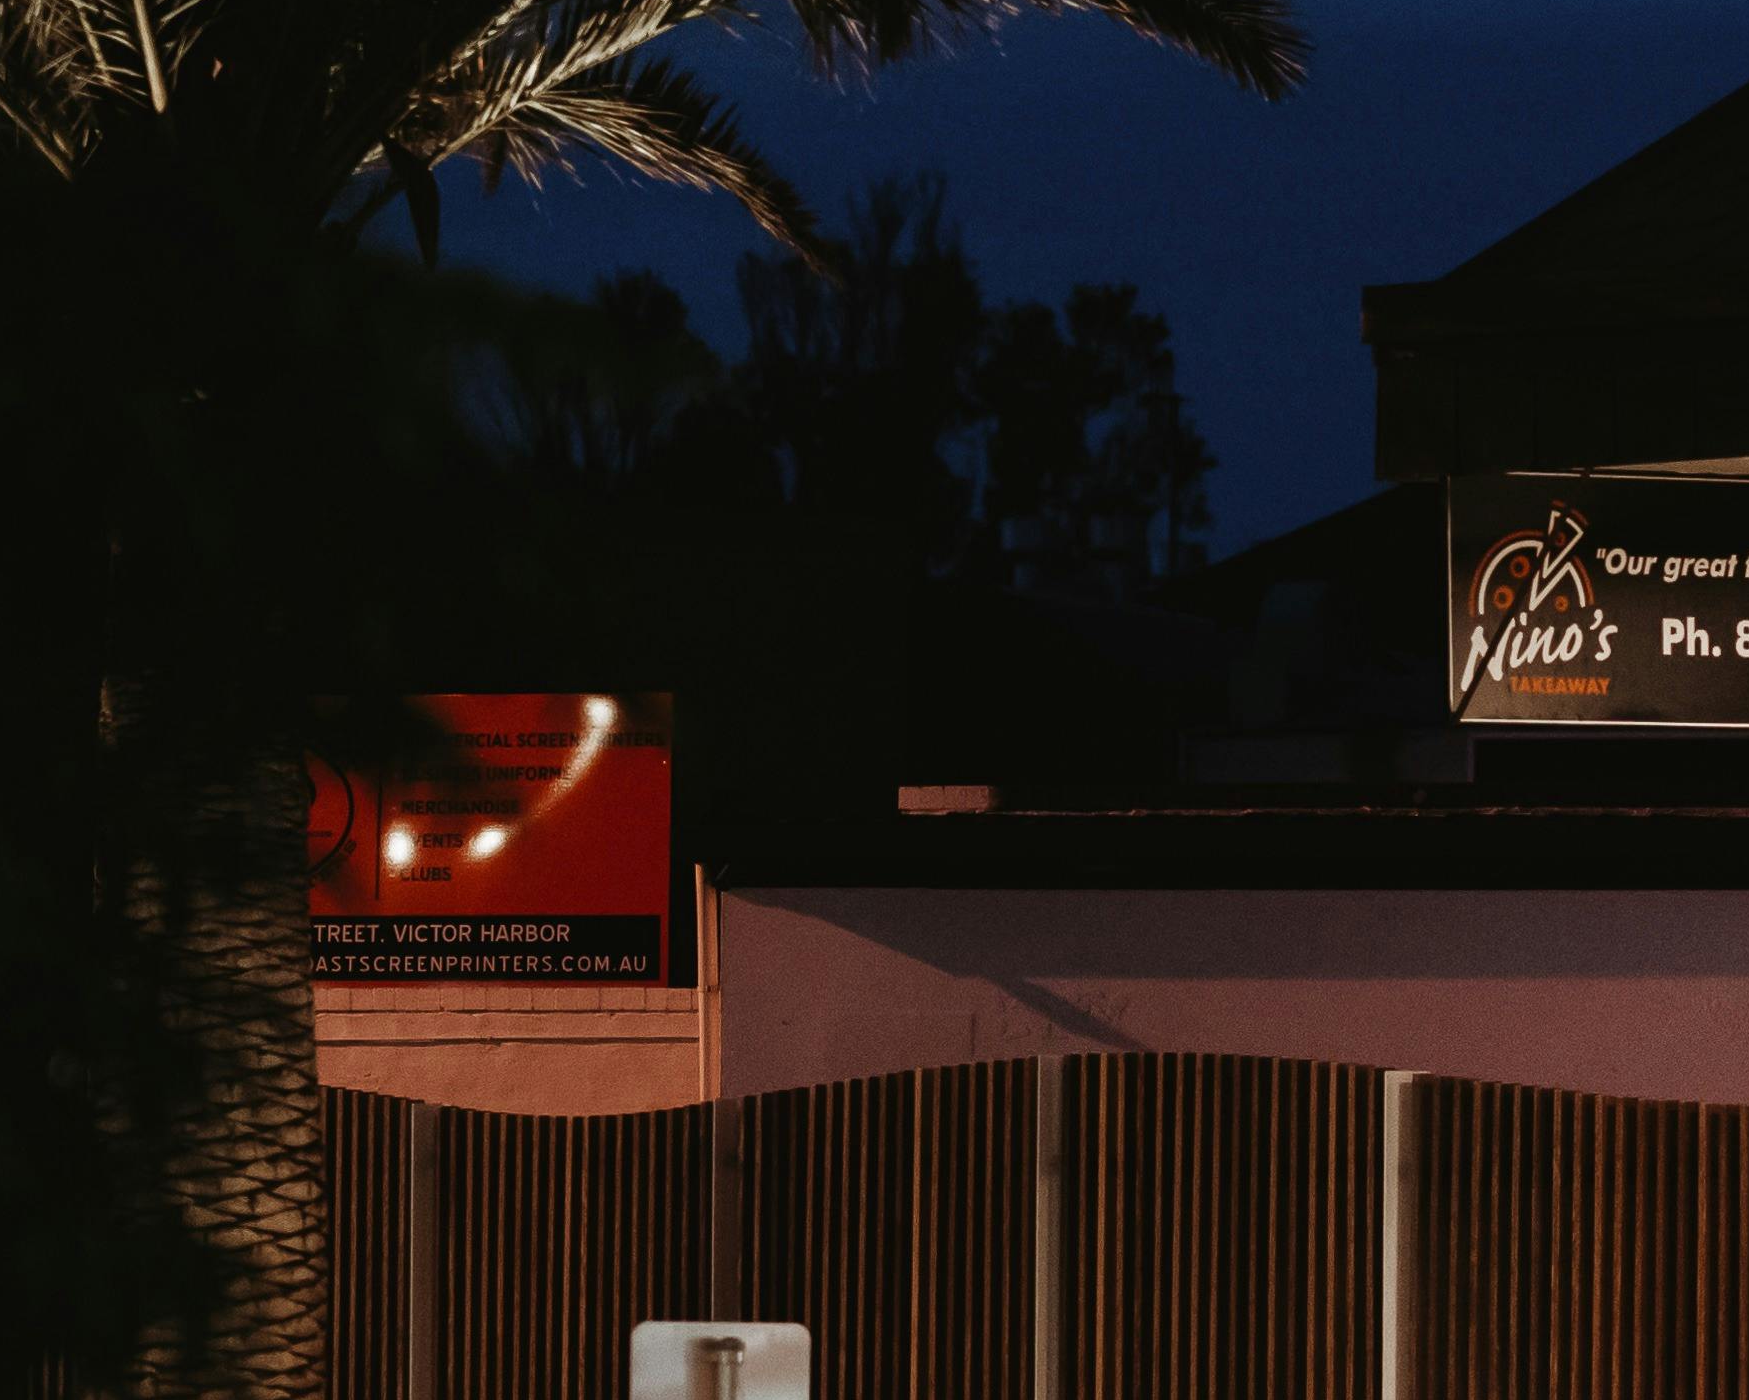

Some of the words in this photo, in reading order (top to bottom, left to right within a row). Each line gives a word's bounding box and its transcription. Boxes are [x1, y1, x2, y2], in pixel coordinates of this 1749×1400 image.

[1662, 553, 1738, 584] great
[1661, 616, 1722, 658] Ph.
[1459, 608, 1619, 693] Nino's
[1509, 675, 1612, 696] TAKEAWAY
[516, 732, 580, 748] SCREEN
[485, 766, 571, 781] UNIFORM
[409, 833, 464, 849] ENTS
[313, 924, 385, 943] TREET.
[393, 924, 472, 943] VICTOR
[480, 924, 571, 943] HARBOR
[310, 955, 648, 973] ASTSCREENPRINTERS.COM.AU
